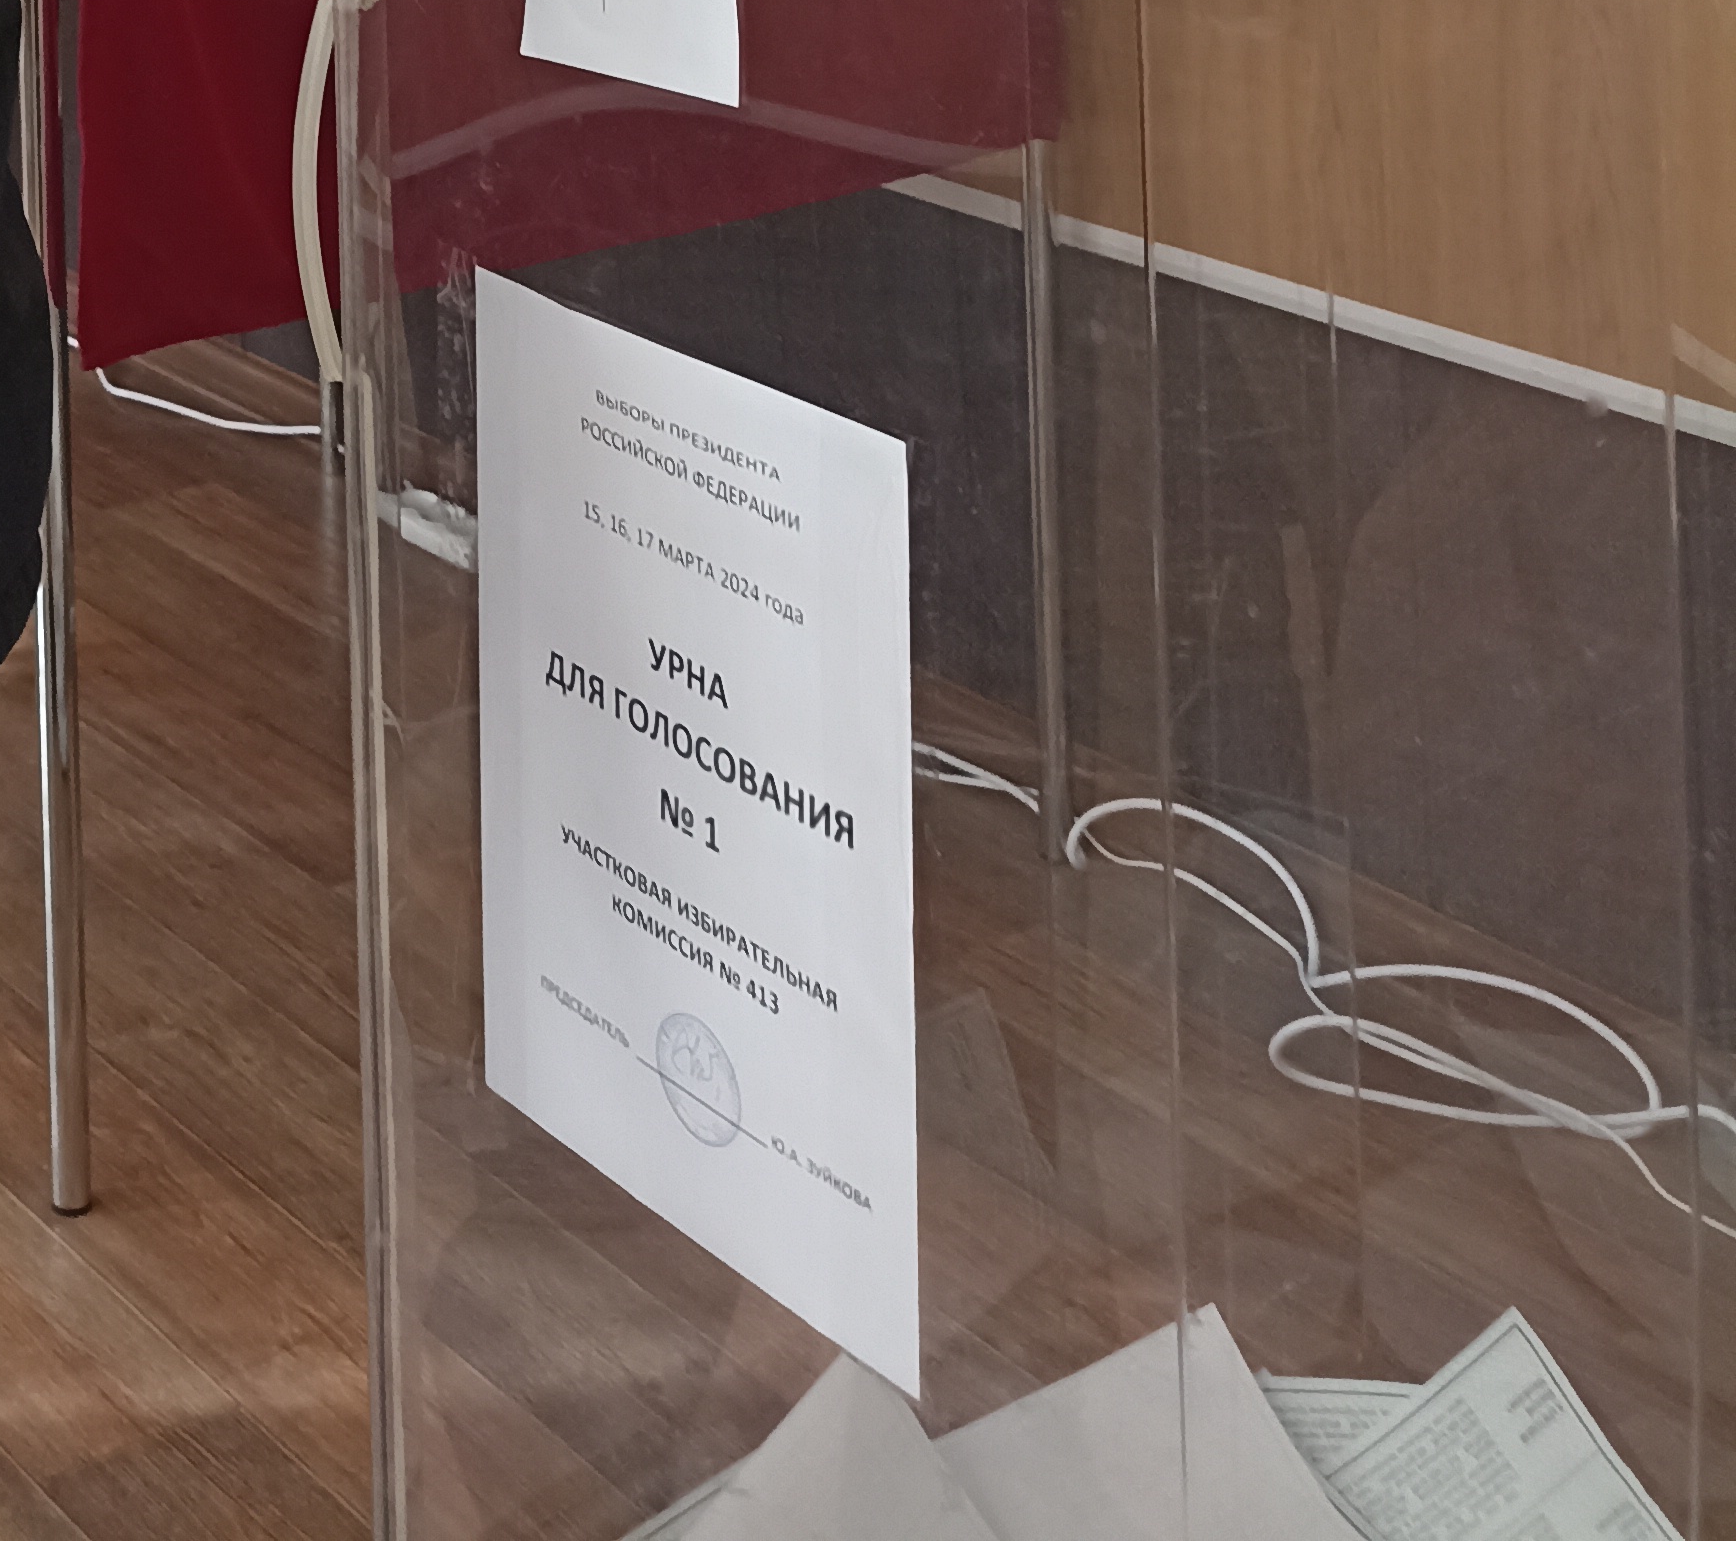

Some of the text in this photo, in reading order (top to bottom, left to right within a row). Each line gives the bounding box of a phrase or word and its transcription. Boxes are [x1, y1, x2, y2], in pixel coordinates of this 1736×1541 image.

[580, 416, 801, 533] РОССИЙСКОЙ ФЕДЕРАЦИИ
[595, 389, 781, 482] ВЫБОРЫ ПРЕЗИДЕНТА
[583, 500, 805, 626] 15, 16, 17 МАРТА 2024 года
[647, 637, 729, 709] УРНА
[545, 649, 855, 850] ДЛЯ ГОЛОСОВАНИЯ
[659, 788, 721, 854] № 1
[560, 823, 839, 1013] УЧАСТКОВАЯ ИЗБИРАТЕЛЬНАЯ
[611, 894, 780, 1015] КОМИССИЯ № 413
[539, 974, 630, 1048] ПРЕДСЕДАТЕЛЬ
[806, 1157, 872, 1211] ЗУЙКОВА
